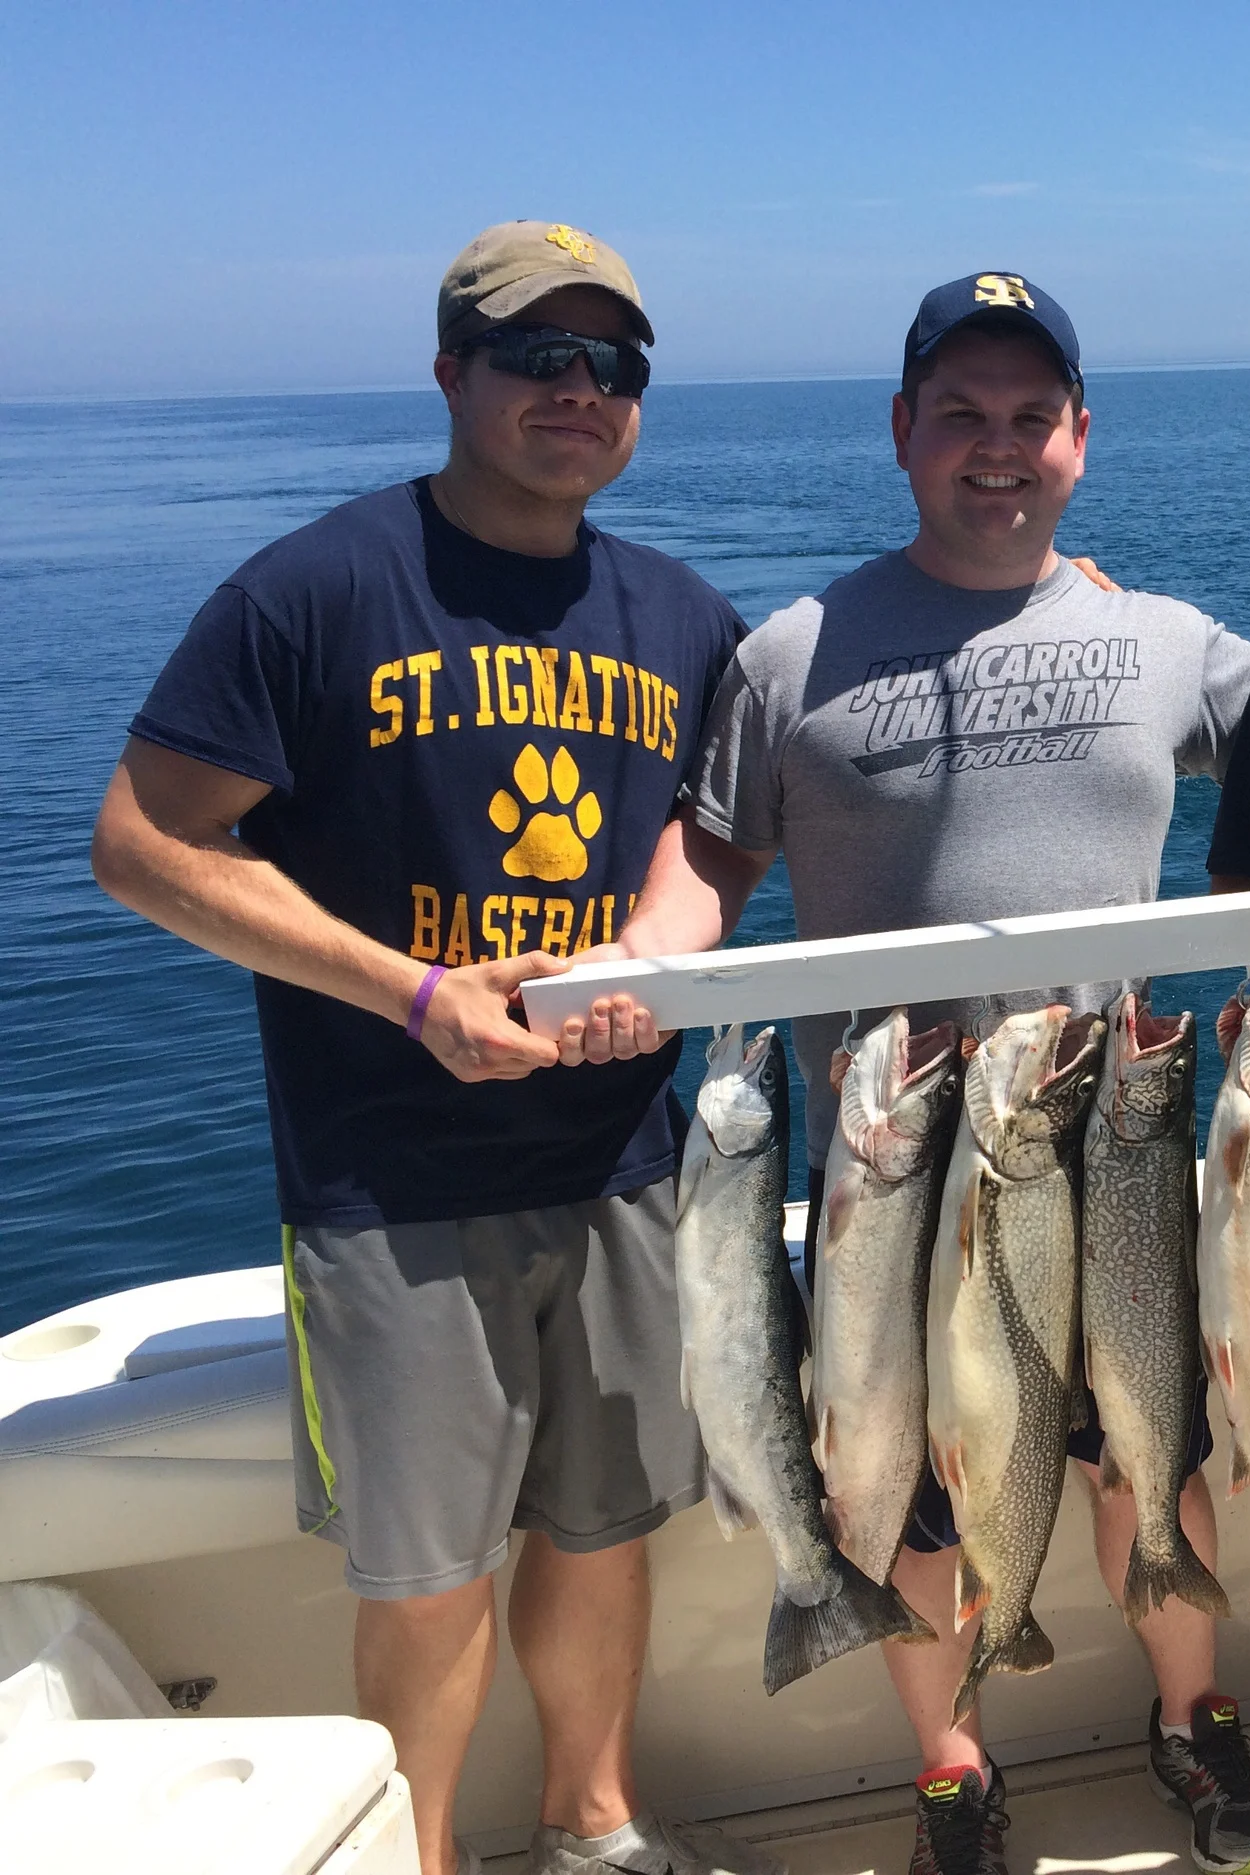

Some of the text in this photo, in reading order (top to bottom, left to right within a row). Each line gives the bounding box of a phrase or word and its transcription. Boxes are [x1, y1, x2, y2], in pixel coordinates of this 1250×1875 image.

[370, 645, 679, 762] ST. IGNATIUS
[849, 638, 1141, 713] JOHN CARROLL
[865, 679, 1123, 752] UNIVERSITY
[917, 730, 1099, 779] Football
[409, 884, 637, 966] BASEBAL
